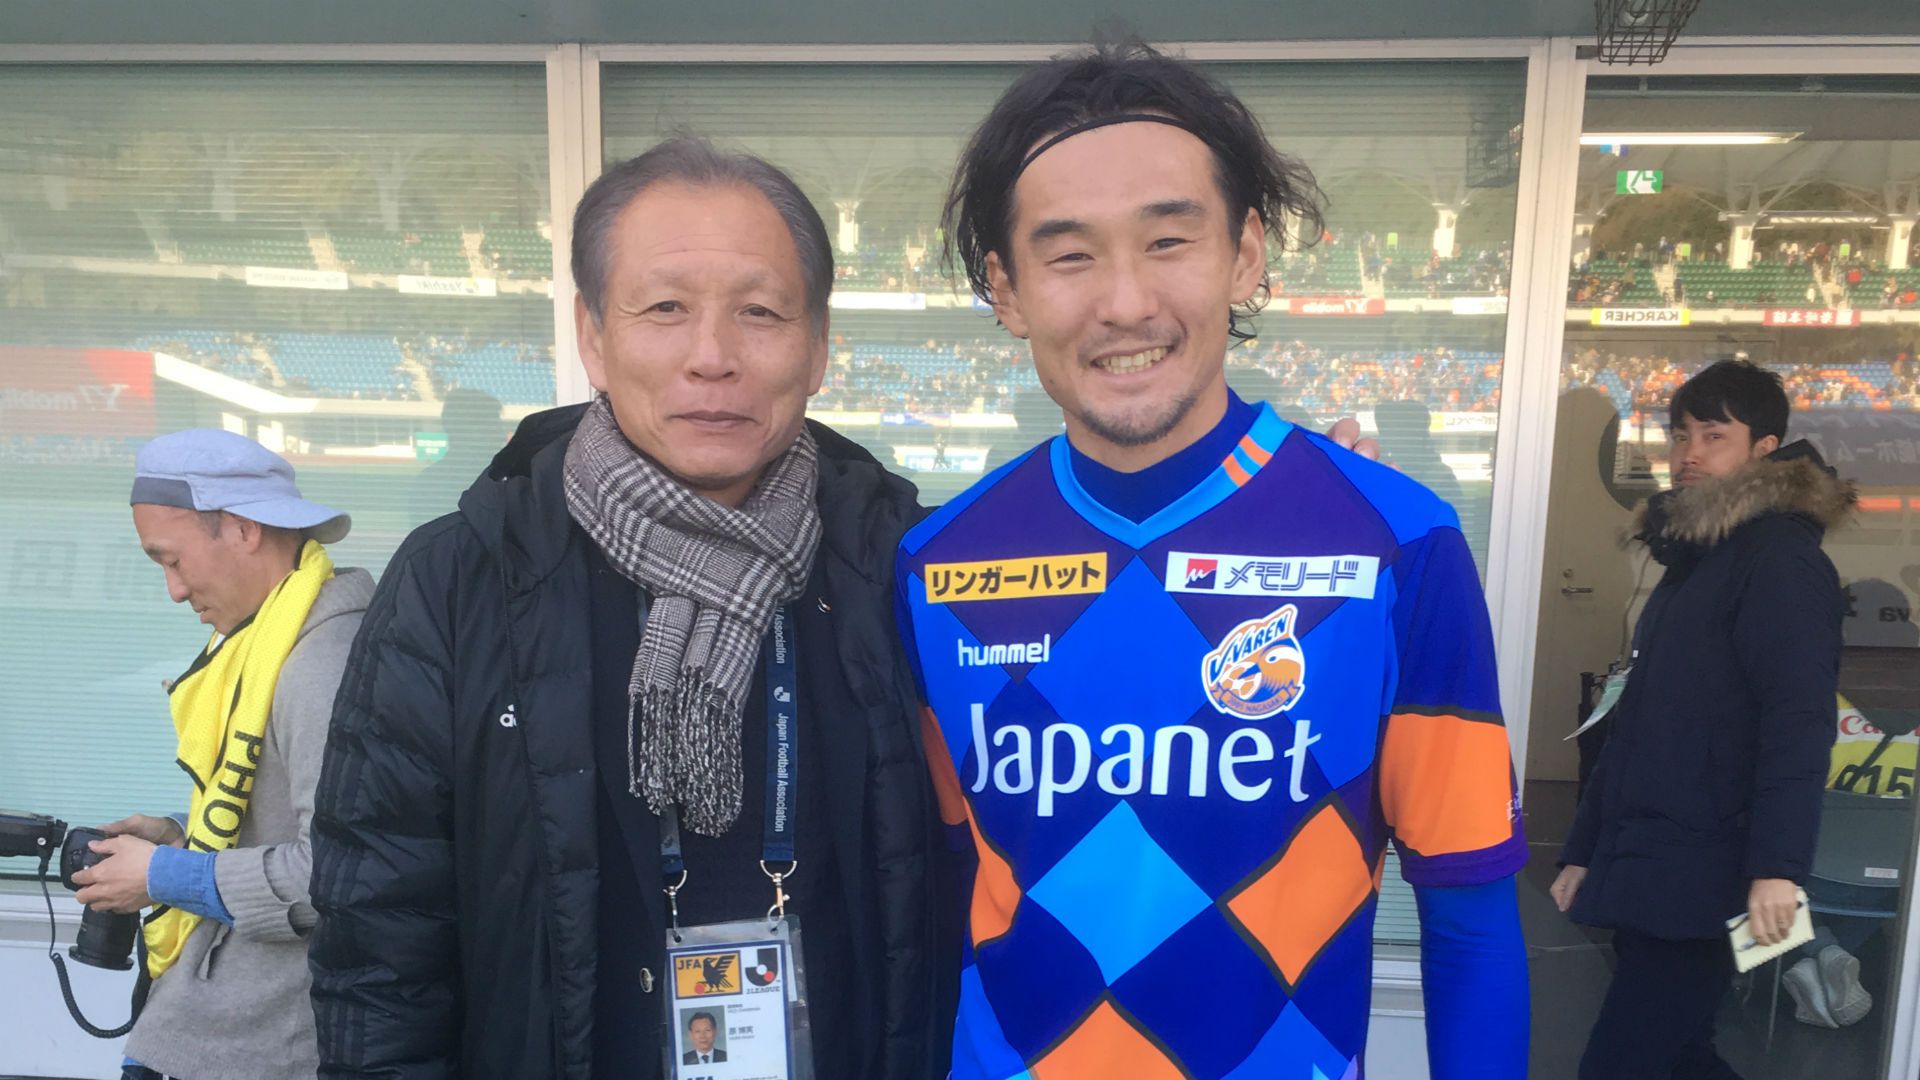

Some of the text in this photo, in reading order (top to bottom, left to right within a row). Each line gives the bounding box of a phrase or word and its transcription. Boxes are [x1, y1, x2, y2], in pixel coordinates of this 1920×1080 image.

[932, 560, 1101, 596] リンガーハット
[1224, 560, 1359, 592] メモリード
[774, 614, 787, 664] Association
[957, 634, 1050, 667] hummel
[775, 713, 789, 832] Japan Football Association
[970, 703, 1322, 816] Japanet
[677, 957, 702, 970] JFA
